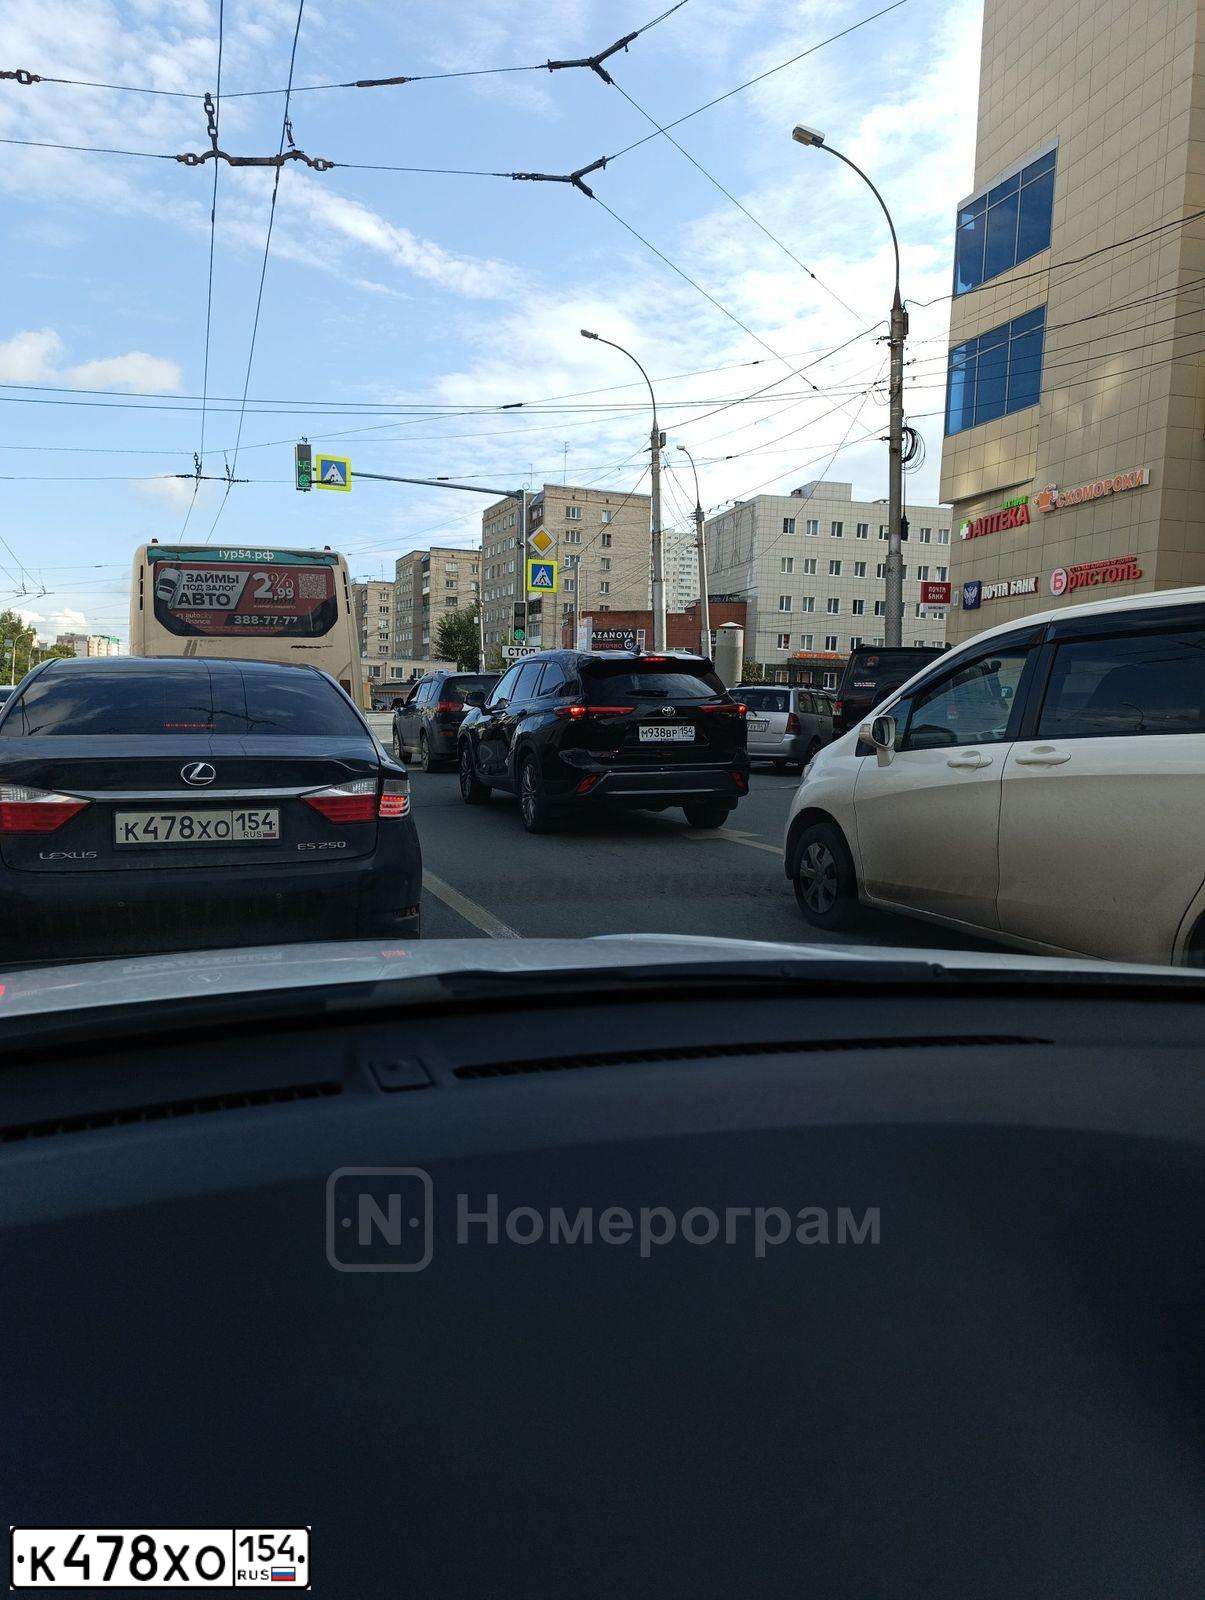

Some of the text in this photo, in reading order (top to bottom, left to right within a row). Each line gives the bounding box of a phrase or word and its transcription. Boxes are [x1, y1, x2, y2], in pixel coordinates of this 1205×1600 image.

[974, 504, 1030, 538] АПТЕКА
[185, 572, 239, 584] ЗАЙМЫ
[183, 584, 237, 592] ПОД ЗАЛОГ
[981, 577, 1038, 600] ПОЧТА БАНК
[178, 592, 231, 606] АВТО
[233, 615, 298, 625] 388-77-77
[591, 631, 634, 639] AZANOVA
[641, 726, 693, 738] М938ВР 154
[124, 812, 273, 841] К478ХО 154
[297, 841, 347, 850] ES 250
[39, 851, 97, 860] LEXUS
